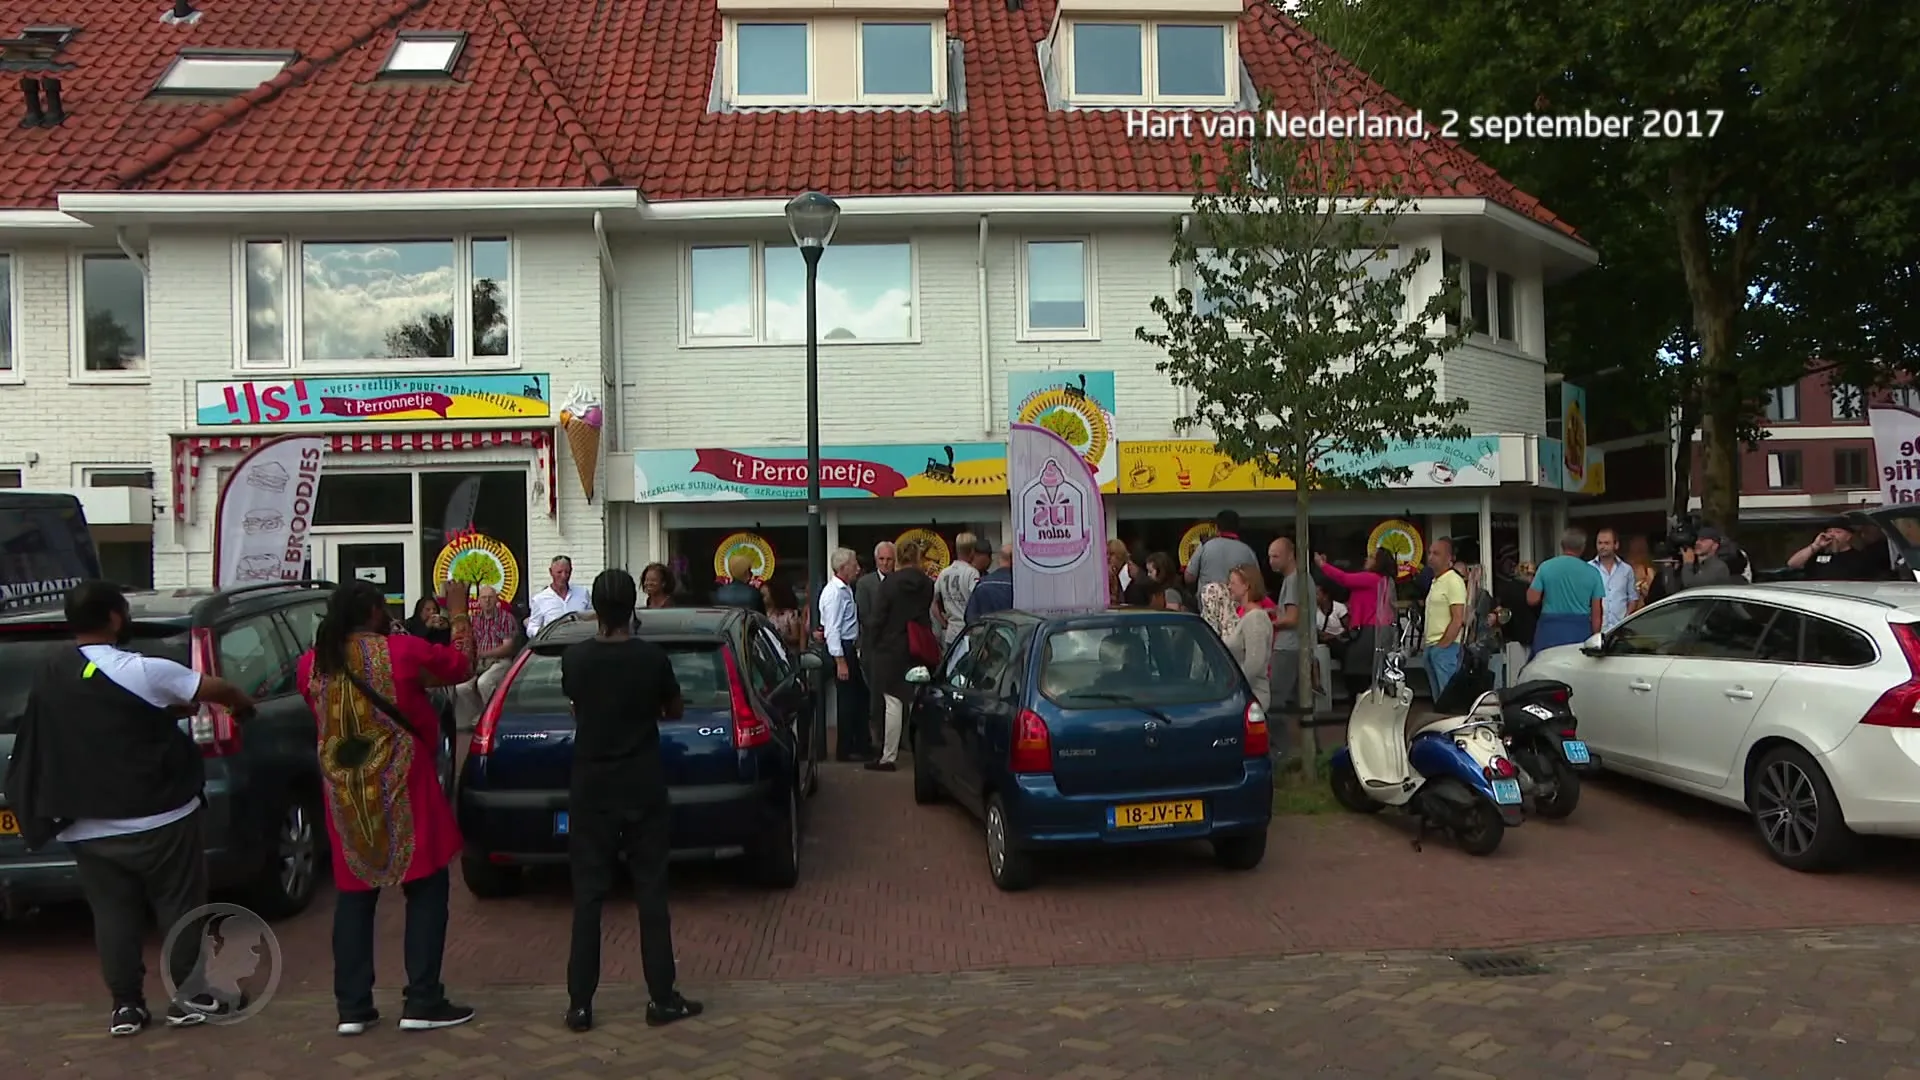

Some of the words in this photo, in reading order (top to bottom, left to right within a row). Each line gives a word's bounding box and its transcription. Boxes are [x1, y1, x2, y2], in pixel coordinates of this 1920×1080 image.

[330, 384, 353, 394] vers
[361, 377, 401, 393] eerlijk
[409, 382, 436, 394] puur
[443, 385, 517, 412] ambachtelijk
[357, 393, 433, 414] Perronnetje
[1175, 444, 1196, 454] VAN
[751, 458, 877, 486] Perronetje
[285, 447, 320, 562] BROODJES
[943, 574, 960, 592] 14
[697, 725, 726, 736] C4
[1126, 803, 1193, 823] 18-JV-FX
